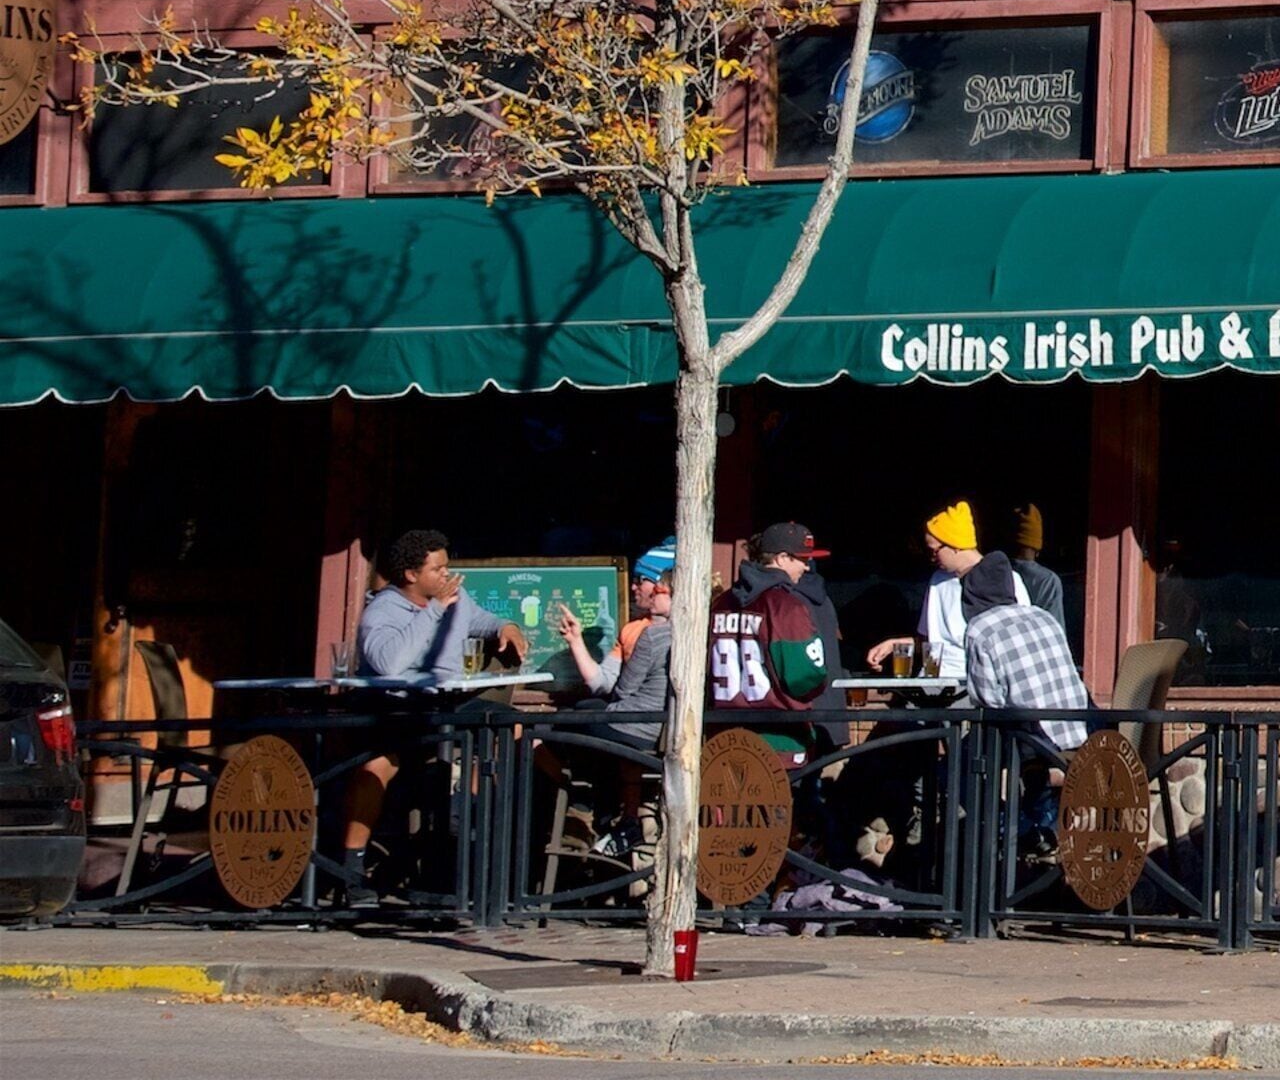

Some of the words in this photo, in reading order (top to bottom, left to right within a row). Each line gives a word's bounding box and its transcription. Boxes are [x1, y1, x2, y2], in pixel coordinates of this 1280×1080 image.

[963, 69, 1082, 113] SAMUEL
[968, 105, 1072, 147] ADAMS
[881, 323, 1010, 372] Collins
[1023, 318, 1114, 369] Irish
[1131, 313, 1205, 364] Pub
[1218, 311, 1254, 360] &
[507, 572, 543, 585] JAMESON
[707, 732, 737, 756] PUB
[709, 783, 725, 797] RT
[214, 808, 312, 834] COLLINS
[699, 803, 788, 829] OLLINS
[1062, 805, 1149, 833] COLLINS
